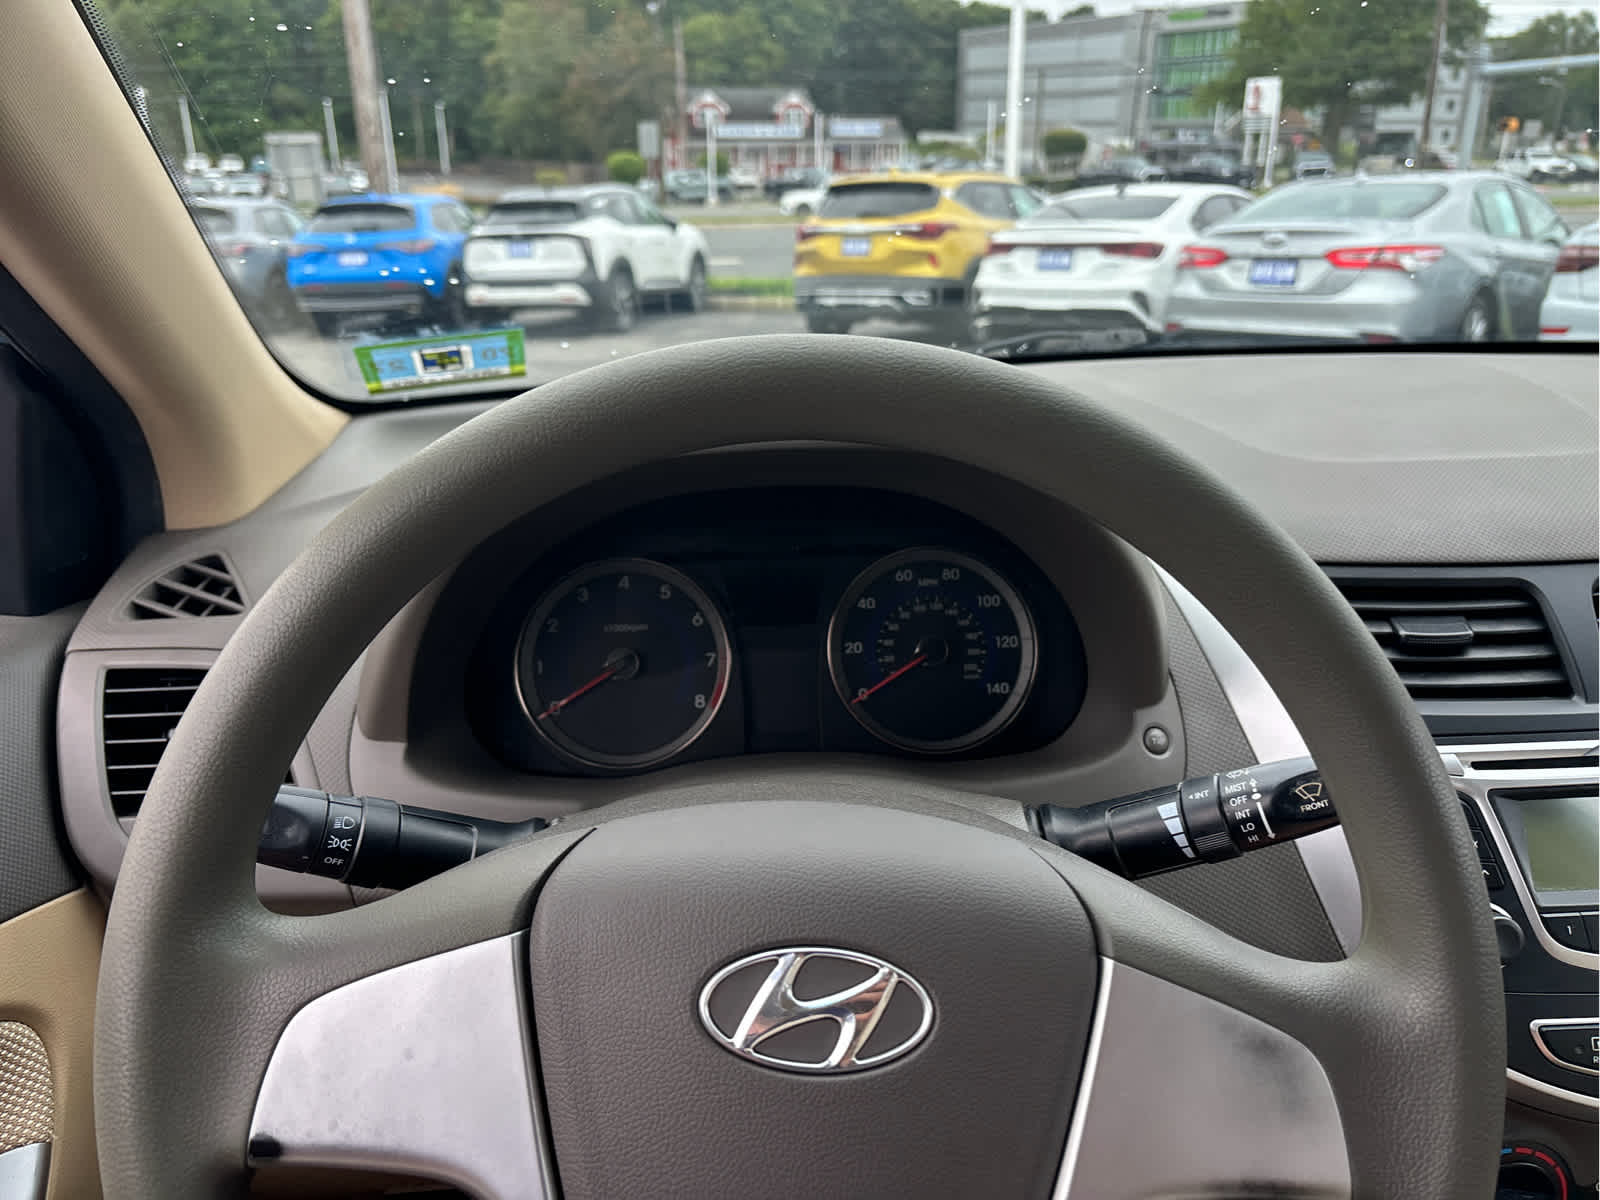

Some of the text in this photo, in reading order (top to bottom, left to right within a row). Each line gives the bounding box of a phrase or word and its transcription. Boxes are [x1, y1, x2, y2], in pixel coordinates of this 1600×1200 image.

[896, 569, 913, 582] 60
[942, 568, 960, 580] 80
[618, 576, 630, 590] 4
[577, 588, 589, 602] 3
[659, 584, 671, 600] 5
[857, 597, 876, 609] 40
[977, 594, 1001, 608] 100
[547, 618, 558, 633] 2
[692, 612, 703, 627] 6
[844, 641, 863, 654] 20
[994, 635, 1018, 649] 120
[705, 652, 716, 668] 7
[986, 681, 1010, 695] 140
[694, 694, 706, 709] 8
[1225, 782, 1248, 795] MIST
[1229, 795, 1248, 807] OFF
[1300, 799, 1329, 813] FRONT
[1234, 809, 1250, 821] INT
[1240, 822, 1255, 833] LO
[1247, 835, 1259, 844] HI
[324, 856, 344, 866] OFF
[1566, 924, 1573, 935] 1
